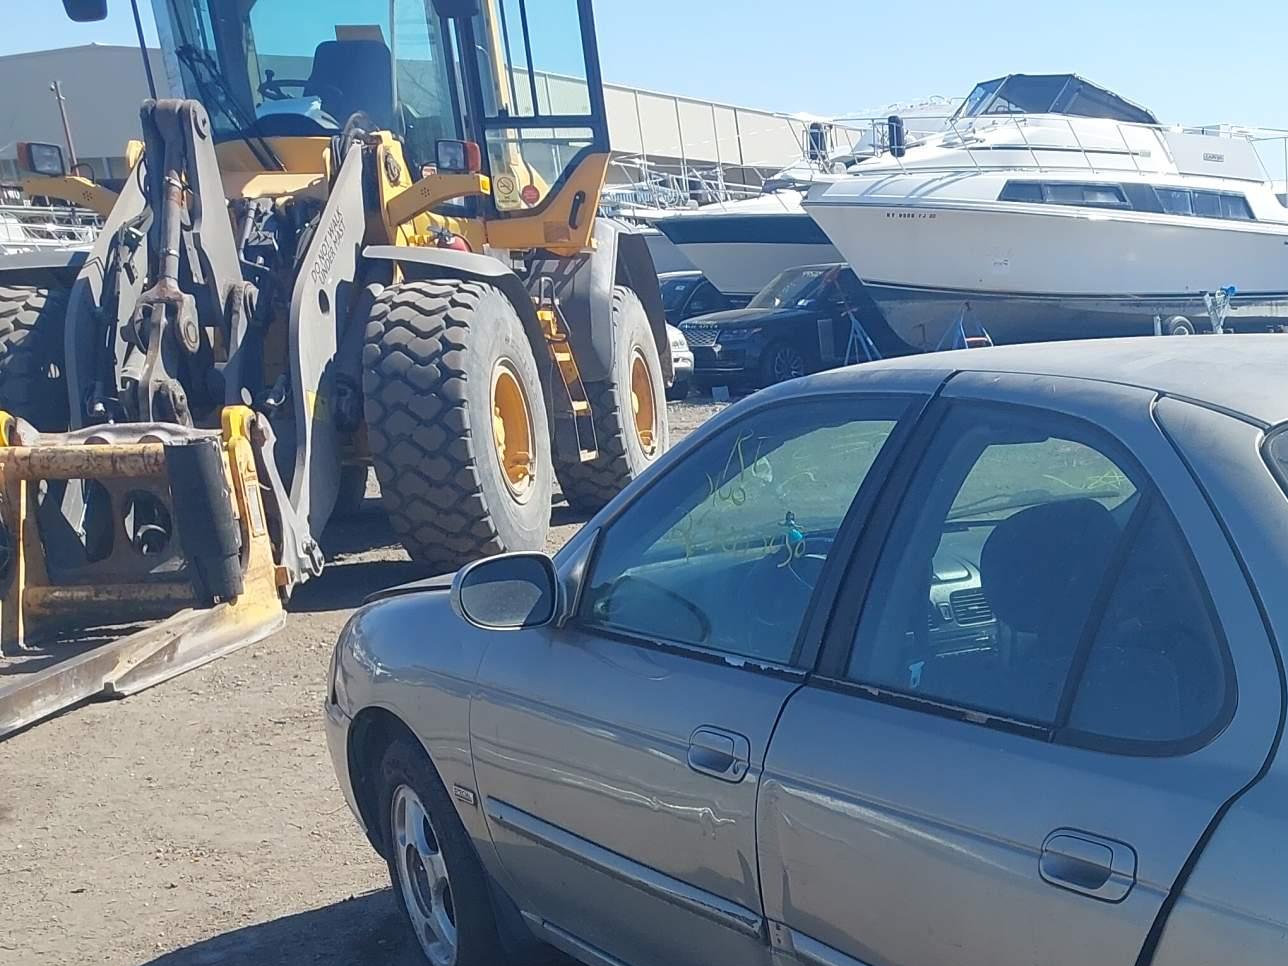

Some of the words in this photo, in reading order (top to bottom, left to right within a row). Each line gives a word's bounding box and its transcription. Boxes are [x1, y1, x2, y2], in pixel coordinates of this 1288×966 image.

[311, 262, 321, 283] DO
[318, 236, 330, 262] NOT
[328, 207, 342, 239] WALK
[319, 247, 336, 285] UNDER
[333, 218, 346, 249] MAST
